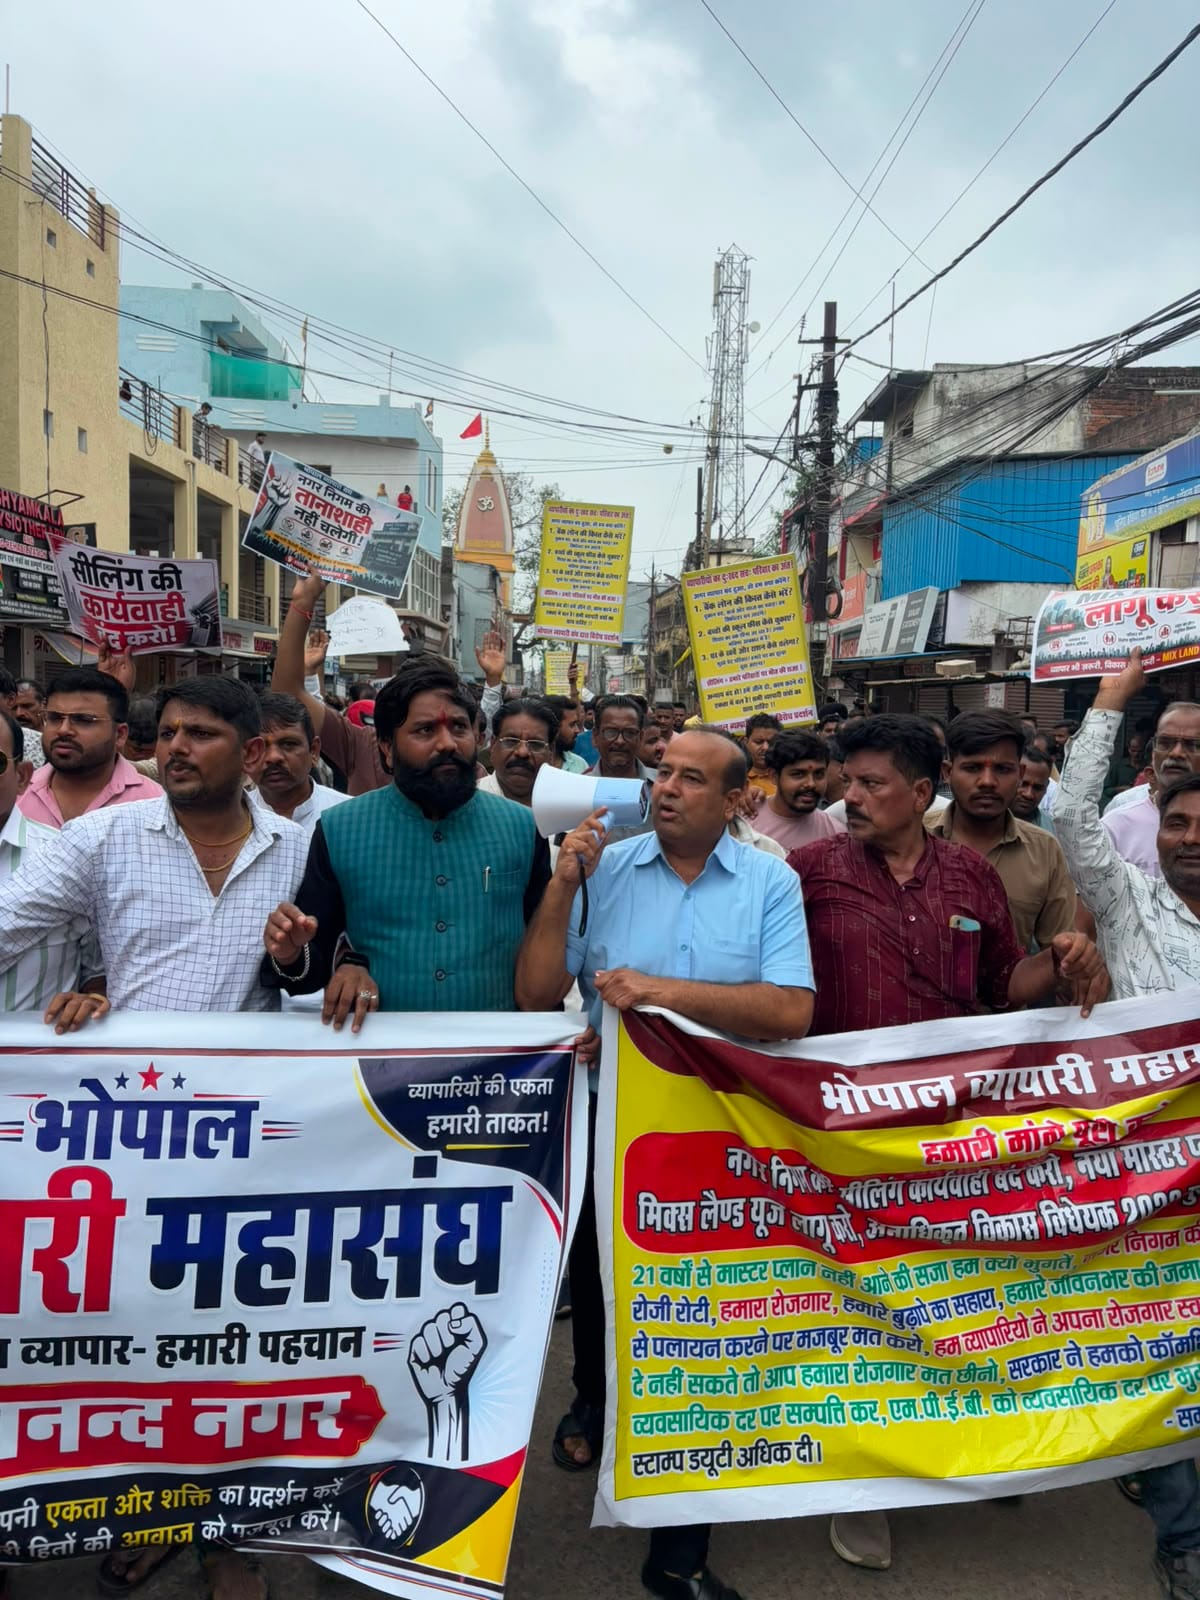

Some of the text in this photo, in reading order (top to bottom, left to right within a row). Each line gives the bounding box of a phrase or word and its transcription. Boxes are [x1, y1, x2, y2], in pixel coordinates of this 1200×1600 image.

[294, 487, 374, 535] तानाशाही
[297, 474, 372, 516] नगर निगम की
[294, 505, 364, 546] नहीं चलेगी!
[68, 551, 143, 591] सीलिंग
[148, 563, 182, 590] की
[80, 591, 186, 622] कार्यवाही
[1083, 595, 1157, 630] लागू
[126, 625, 177, 646] करो!
[1162, 646, 1200, 663] MIX LAND
[408, 1073, 554, 1100] व्यापारियों की एकता
[820, 1072, 956, 1116] भोपाल
[964, 1052, 1097, 1101] व्यापारी
[35, 1078, 259, 1160] भोपाल
[426, 1105, 549, 1138] हमारी ताकत!
[727, 1147, 768, 1183] नगर
[908, 1168, 990, 1204] कार्यवाही
[993, 1163, 1024, 1194] बंद
[1025, 1152, 1073, 1192] करो,
[1074, 1148, 1121, 1182] नया
[1119, 1137, 1189, 1175] मास्टर
[921, 1127, 999, 1167] हमारी
[145, 1154, 514, 1309] महासंघ
[637, 1190, 697, 1233] मिक्स
[699, 1190, 747, 1231] लैण्ड
[748, 1196, 787, 1239] यूज
[789, 1210, 837, 1256] लागू
[828, 1203, 866, 1248] करो,
[969, 1207, 1041, 1243] विकास
[1038, 1195, 1121, 1239] विधेयक
[632, 1265, 655, 1286] 21
[659, 1259, 694, 1288] वर्षों
[696, 1258, 712, 1287] से
[716, 1262, 770, 1285] मास्टर
[772, 1258, 818, 1279] प्लान
[820, 1263, 857, 1289] नहीं
[861, 1267, 895, 1296] आने
[892, 1262, 914, 1291] की
[914, 1261, 950, 1287] सजा
[950, 1257, 980, 1279] हम
[1124, 1230, 1181, 1253] निगम
[632, 1293, 673, 1322] रोजी
[675, 1295, 717, 1327] रोटी,
[719, 1297, 768, 1323] हमारा
[771, 1288, 840, 1316] रोजगार,
[843, 1294, 890, 1322] हमारे
[929, 1297, 954, 1322] का
[951, 1288, 1005, 1317] सहारा,
[1004, 1274, 1048, 1304] हमारे
[1050, 1268, 1131, 1297] जीवनभर
[1130, 1260, 1161, 1288] की
[156, 1322, 251, 1369] हमारी
[259, 1326, 366, 1366] पहचान
[632, 1330, 650, 1359] से
[651, 1336, 722, 1359] पलायन
[723, 1327, 769, 1358] करने
[771, 1329, 796, 1351] पर
[797, 1326, 850, 1354] मजबूर
[851, 1326, 884, 1347] मत
[886, 1333, 931, 1357] करो,
[933, 1335, 962, 1358] हम
[1030, 1307, 1050, 1336] ने
[1051, 1307, 1106, 1333] अपना
[1106, 1298, 1177, 1327] रोजगार
[632, 1333, 1146, 1397] दे नहीं सकते तो आप हमारा रोजगार मत छीनो, सरकार ने हमको
[191, 1391, 351, 1449] नगर
[632, 1403, 733, 1436] व्यवसायिक
[735, 1409, 758, 1431] दर
[758, 1403, 783, 1428] पर
[850, 1398, 888, 1428] कर,
[991, 1386, 1018, 1415] को
[1020, 1376, 1119, 1412] व्यवसायिक
[1119, 1377, 1148, 1399] दर
[1146, 1368, 1176, 1395] पर
[632, 1448, 685, 1478] स्टाम्प
[735, 1436, 793, 1469] अधिक
[0, 1477, 344, 1532] पनी एकता और शक्ति का प्रदर्शन करें
[27, 1531, 77, 1559] हितों
[83, 1527, 113, 1552] की
[121, 1522, 195, 1548] आवाज
[201, 1513, 227, 1541] को
